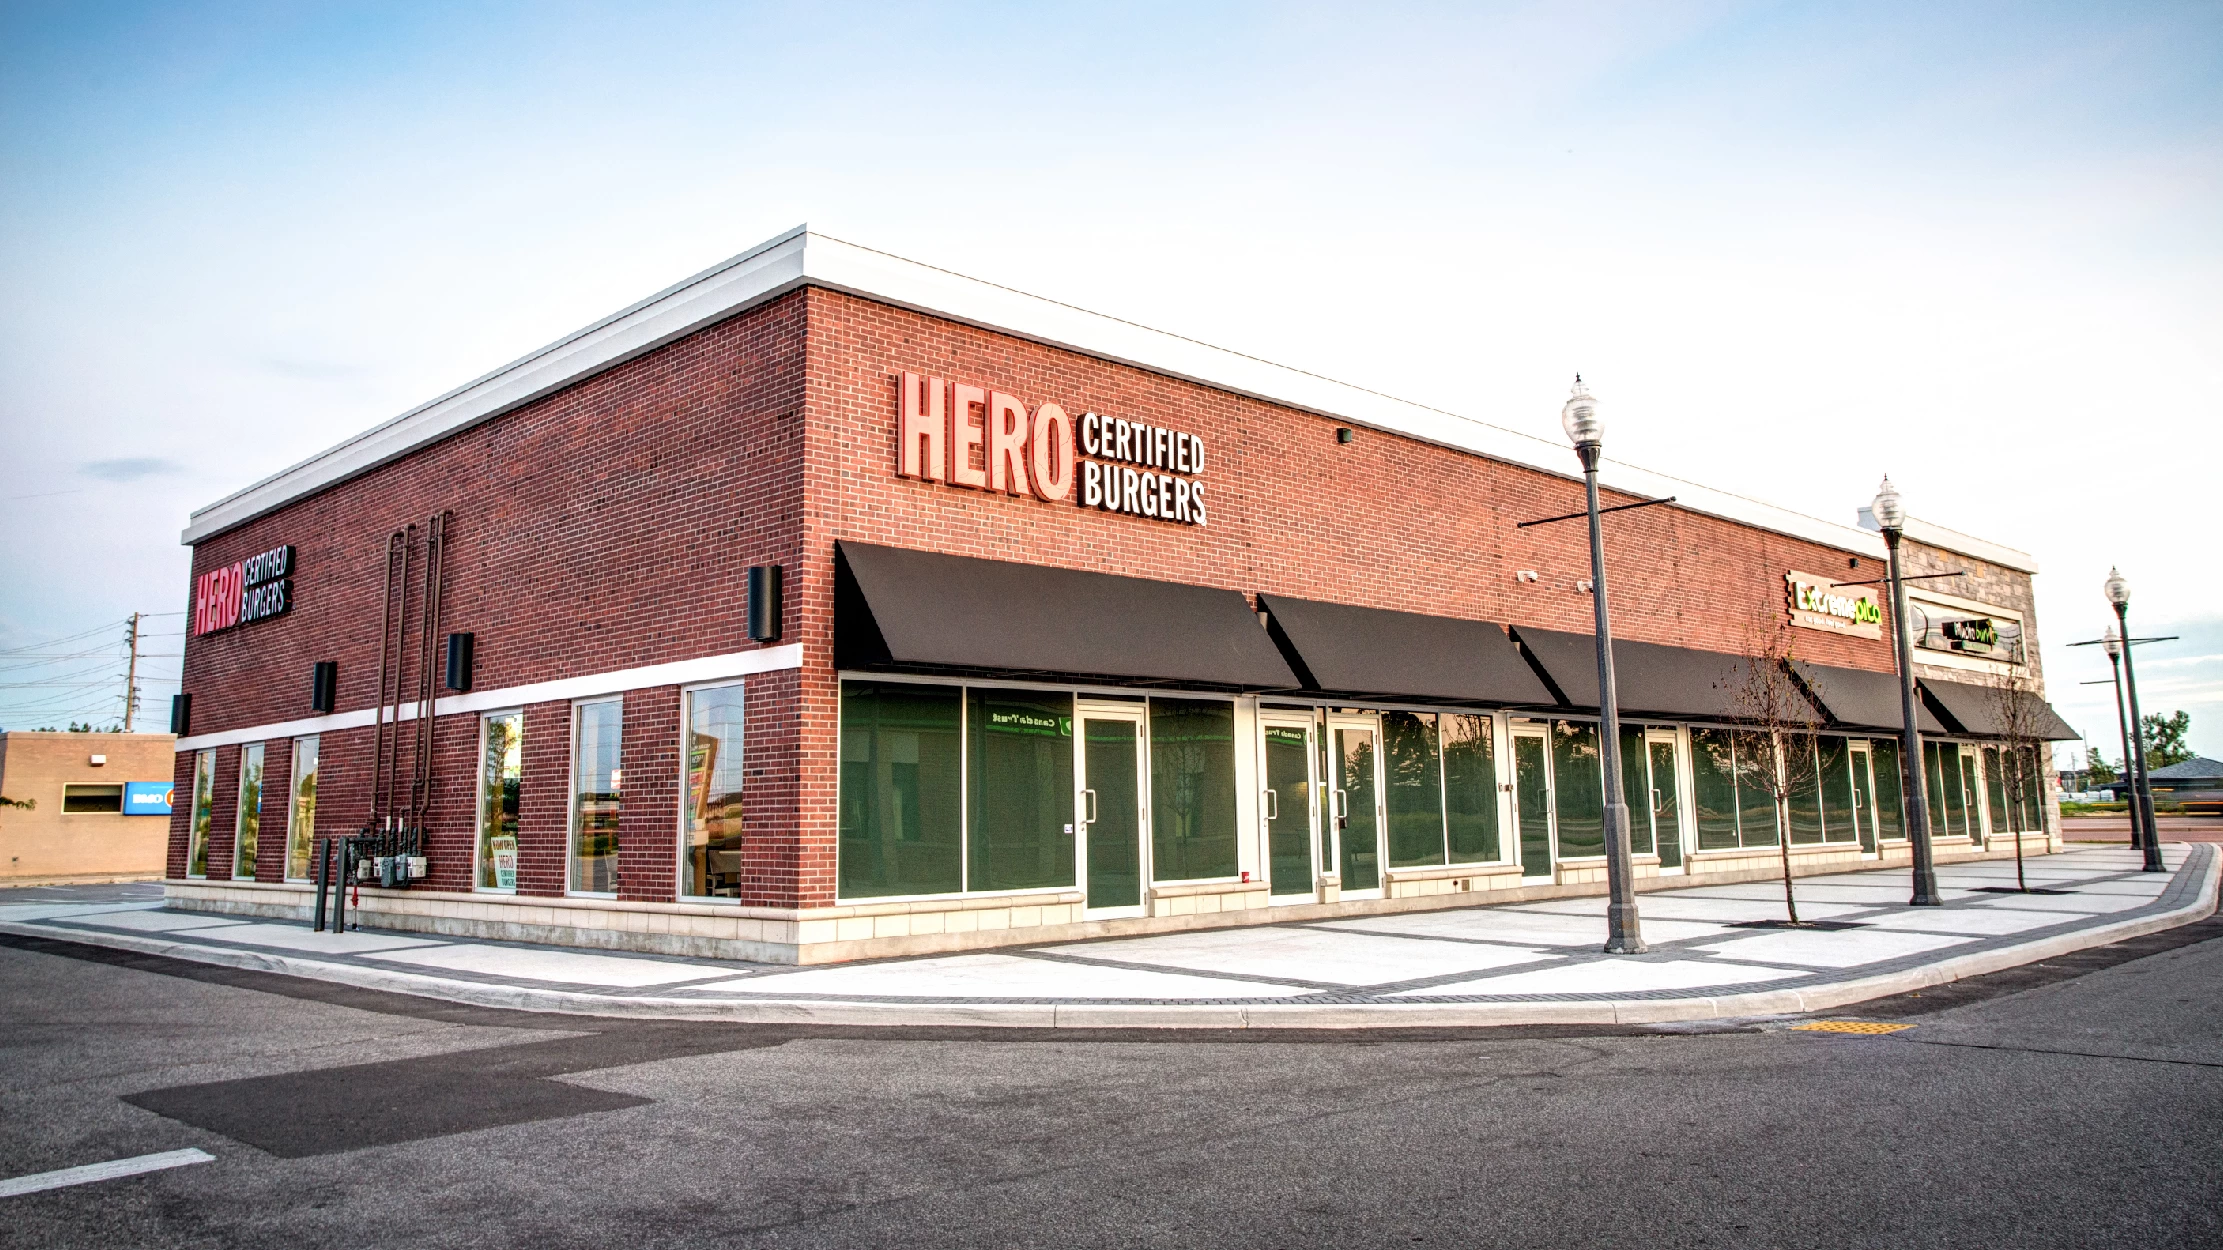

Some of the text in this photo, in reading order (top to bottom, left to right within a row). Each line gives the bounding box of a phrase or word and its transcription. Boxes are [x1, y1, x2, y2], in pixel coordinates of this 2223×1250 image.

[900, 371, 1074, 500] HERO
[1082, 412, 1205, 474] CERTIFIED
[1083, 461, 1206, 525] BURGERS
[244, 545, 288, 587] CERTIFIED
[194, 561, 242, 636] HERO
[241, 579, 285, 622] BURGERS
